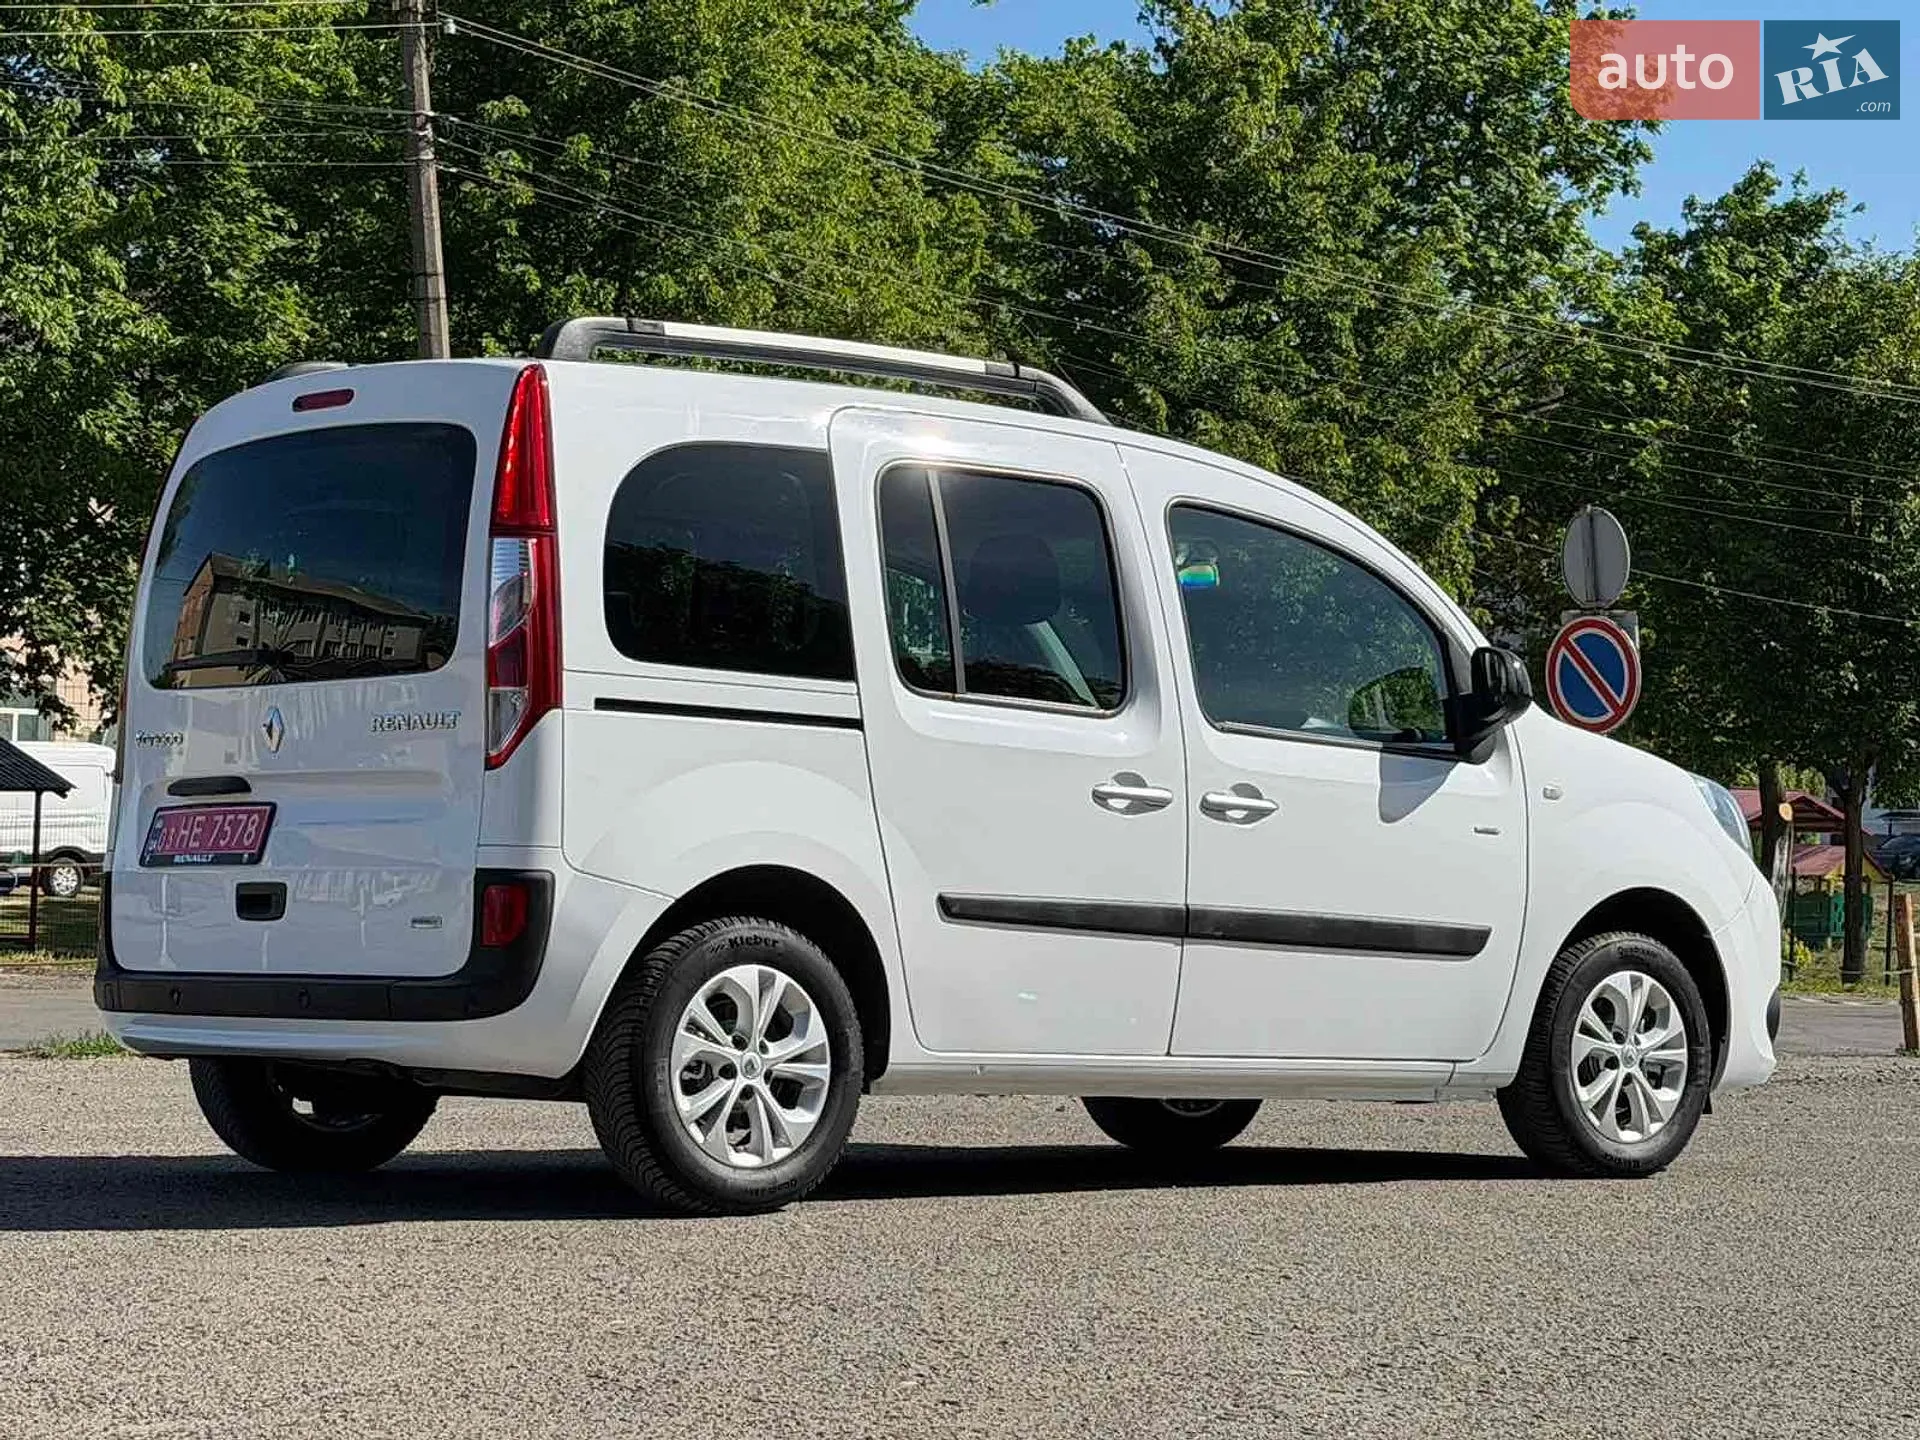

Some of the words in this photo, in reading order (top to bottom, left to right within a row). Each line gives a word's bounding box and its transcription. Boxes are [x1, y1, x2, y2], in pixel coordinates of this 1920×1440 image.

[370, 710, 462, 733] RENAULT
[176, 815, 206, 849] HE
[208, 813, 260, 848] 7578
